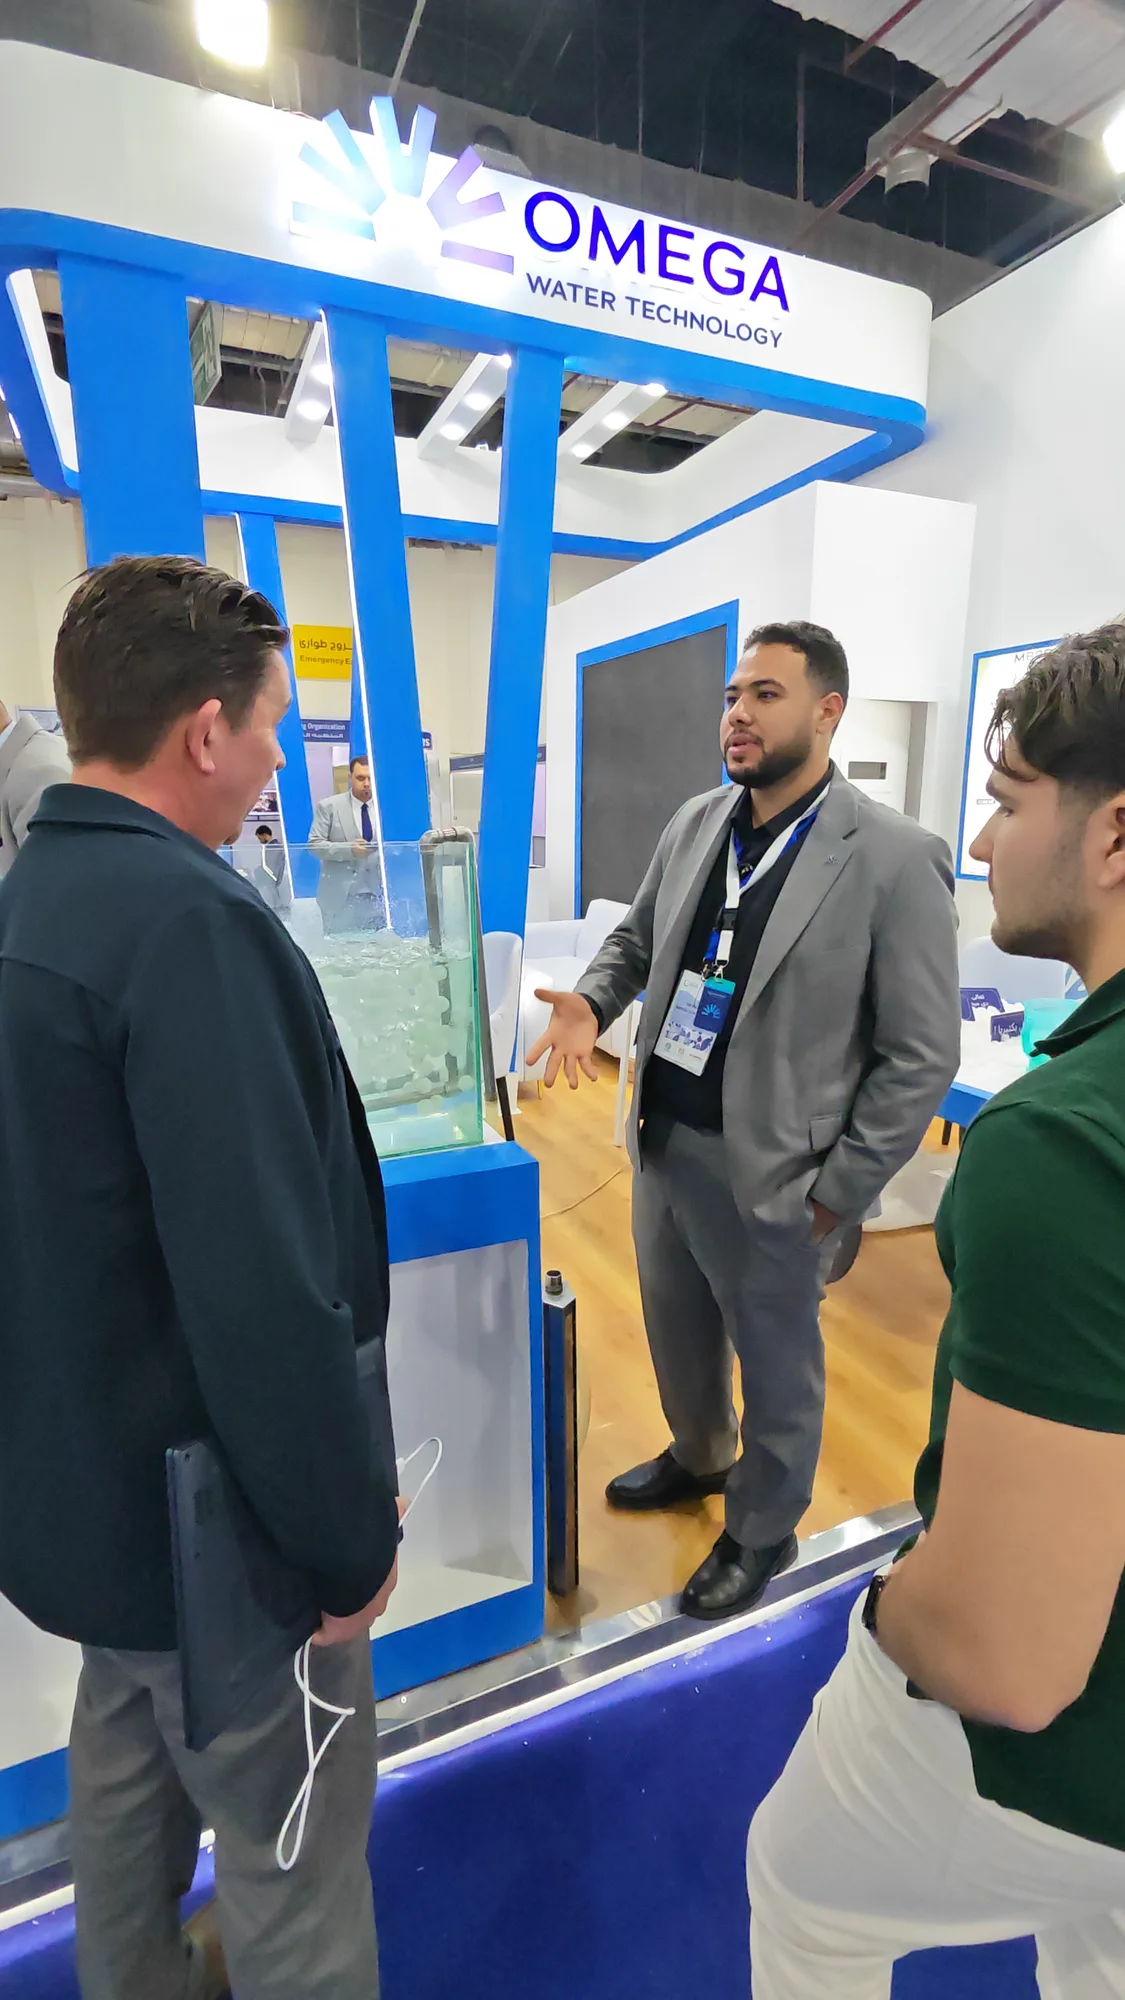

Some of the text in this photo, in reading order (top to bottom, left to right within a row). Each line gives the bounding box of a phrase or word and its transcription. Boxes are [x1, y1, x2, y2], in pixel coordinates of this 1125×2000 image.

[524, 191, 789, 312] OMEGA
[526, 273, 782, 348] WATER TECHNOLOGY
[299, 654, 344, 666] Emergency
[330, 642, 352, 651] روج
